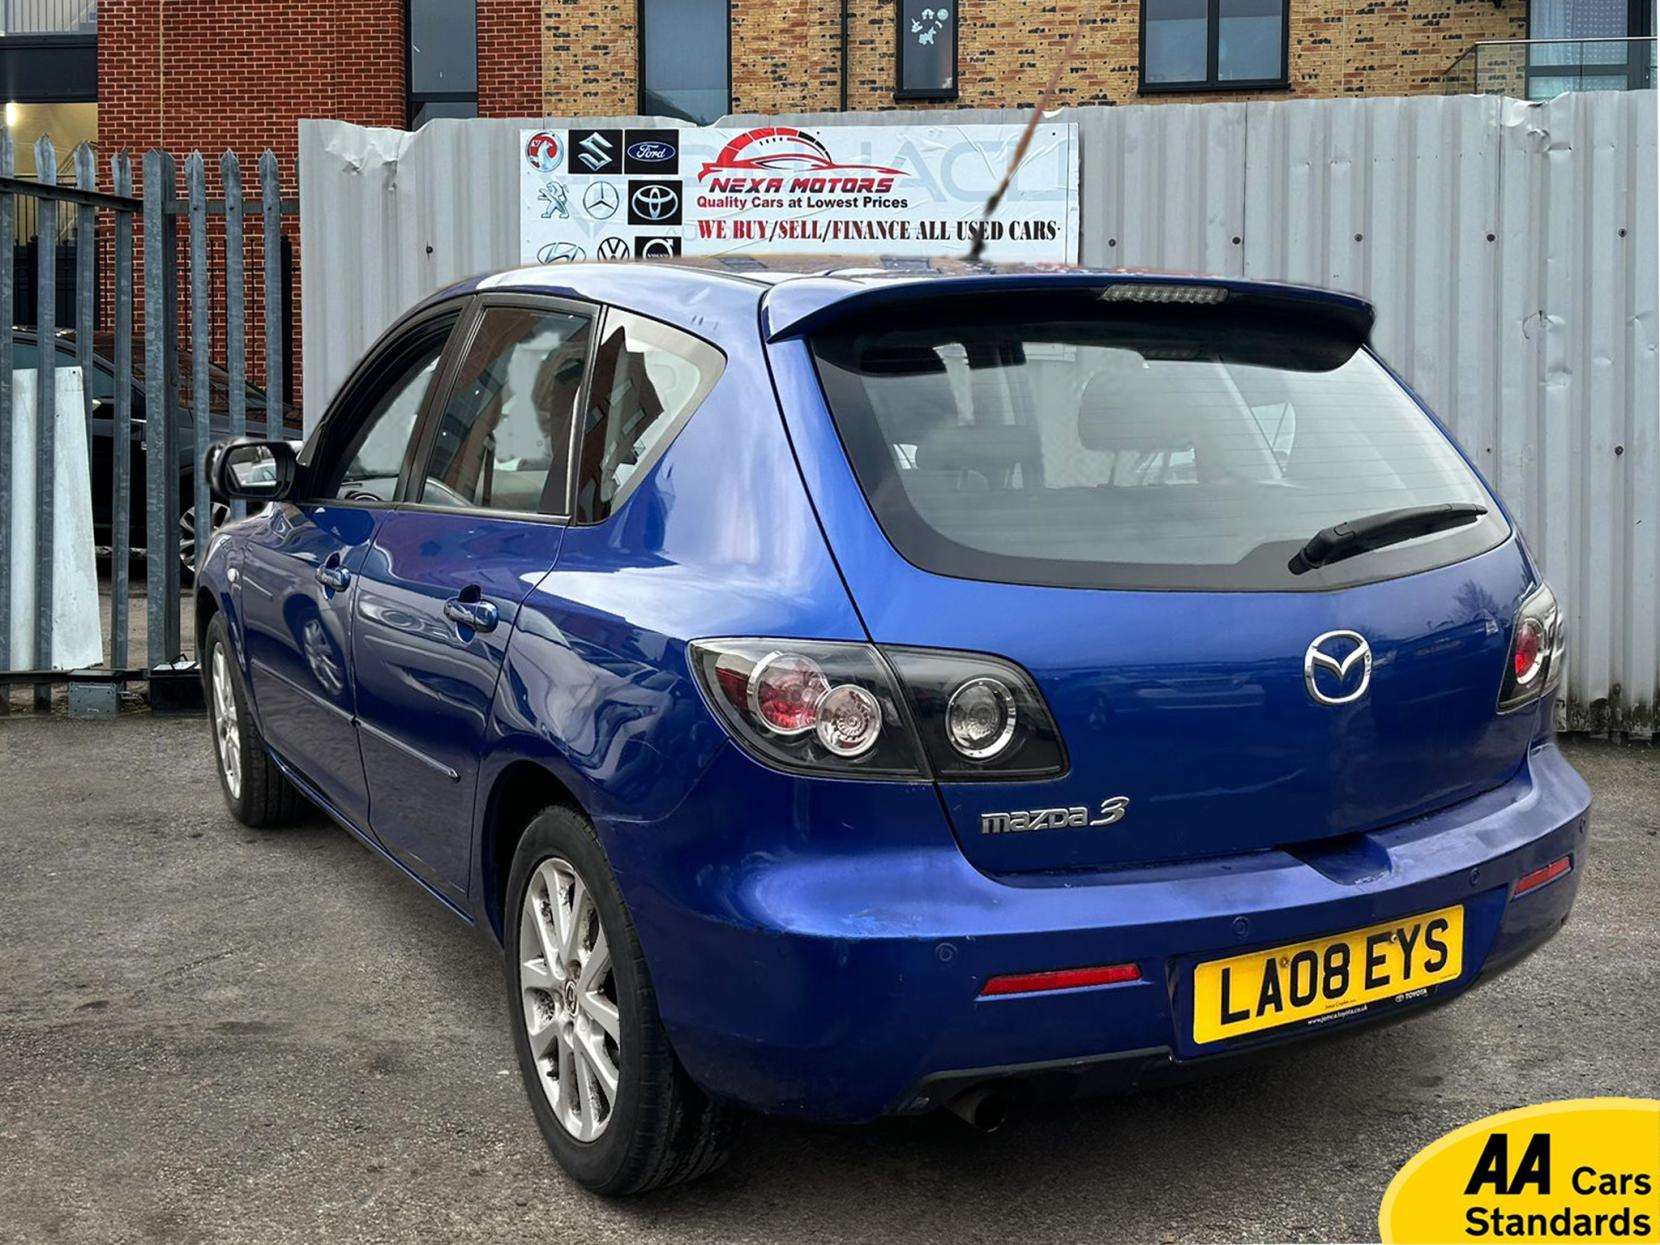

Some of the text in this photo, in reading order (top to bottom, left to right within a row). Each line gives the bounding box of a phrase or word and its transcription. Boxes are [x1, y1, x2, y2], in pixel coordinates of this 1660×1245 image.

[636, 144, 665, 158] Ford
[709, 178, 895, 193] NEXA MOTORS
[697, 196, 908, 210] Quality Cars at Lowest Prices
[697, 220, 727, 240] WE
[733, 219, 911, 243] BUY/SELL/FINANCE
[917, 220, 950, 240] ALL
[957, 220, 1004, 240] USED
[1009, 220, 1057, 240] CARS
[1090, 796, 1130, 826] 3
[1220, 917, 1449, 1026] LA08 EYS
